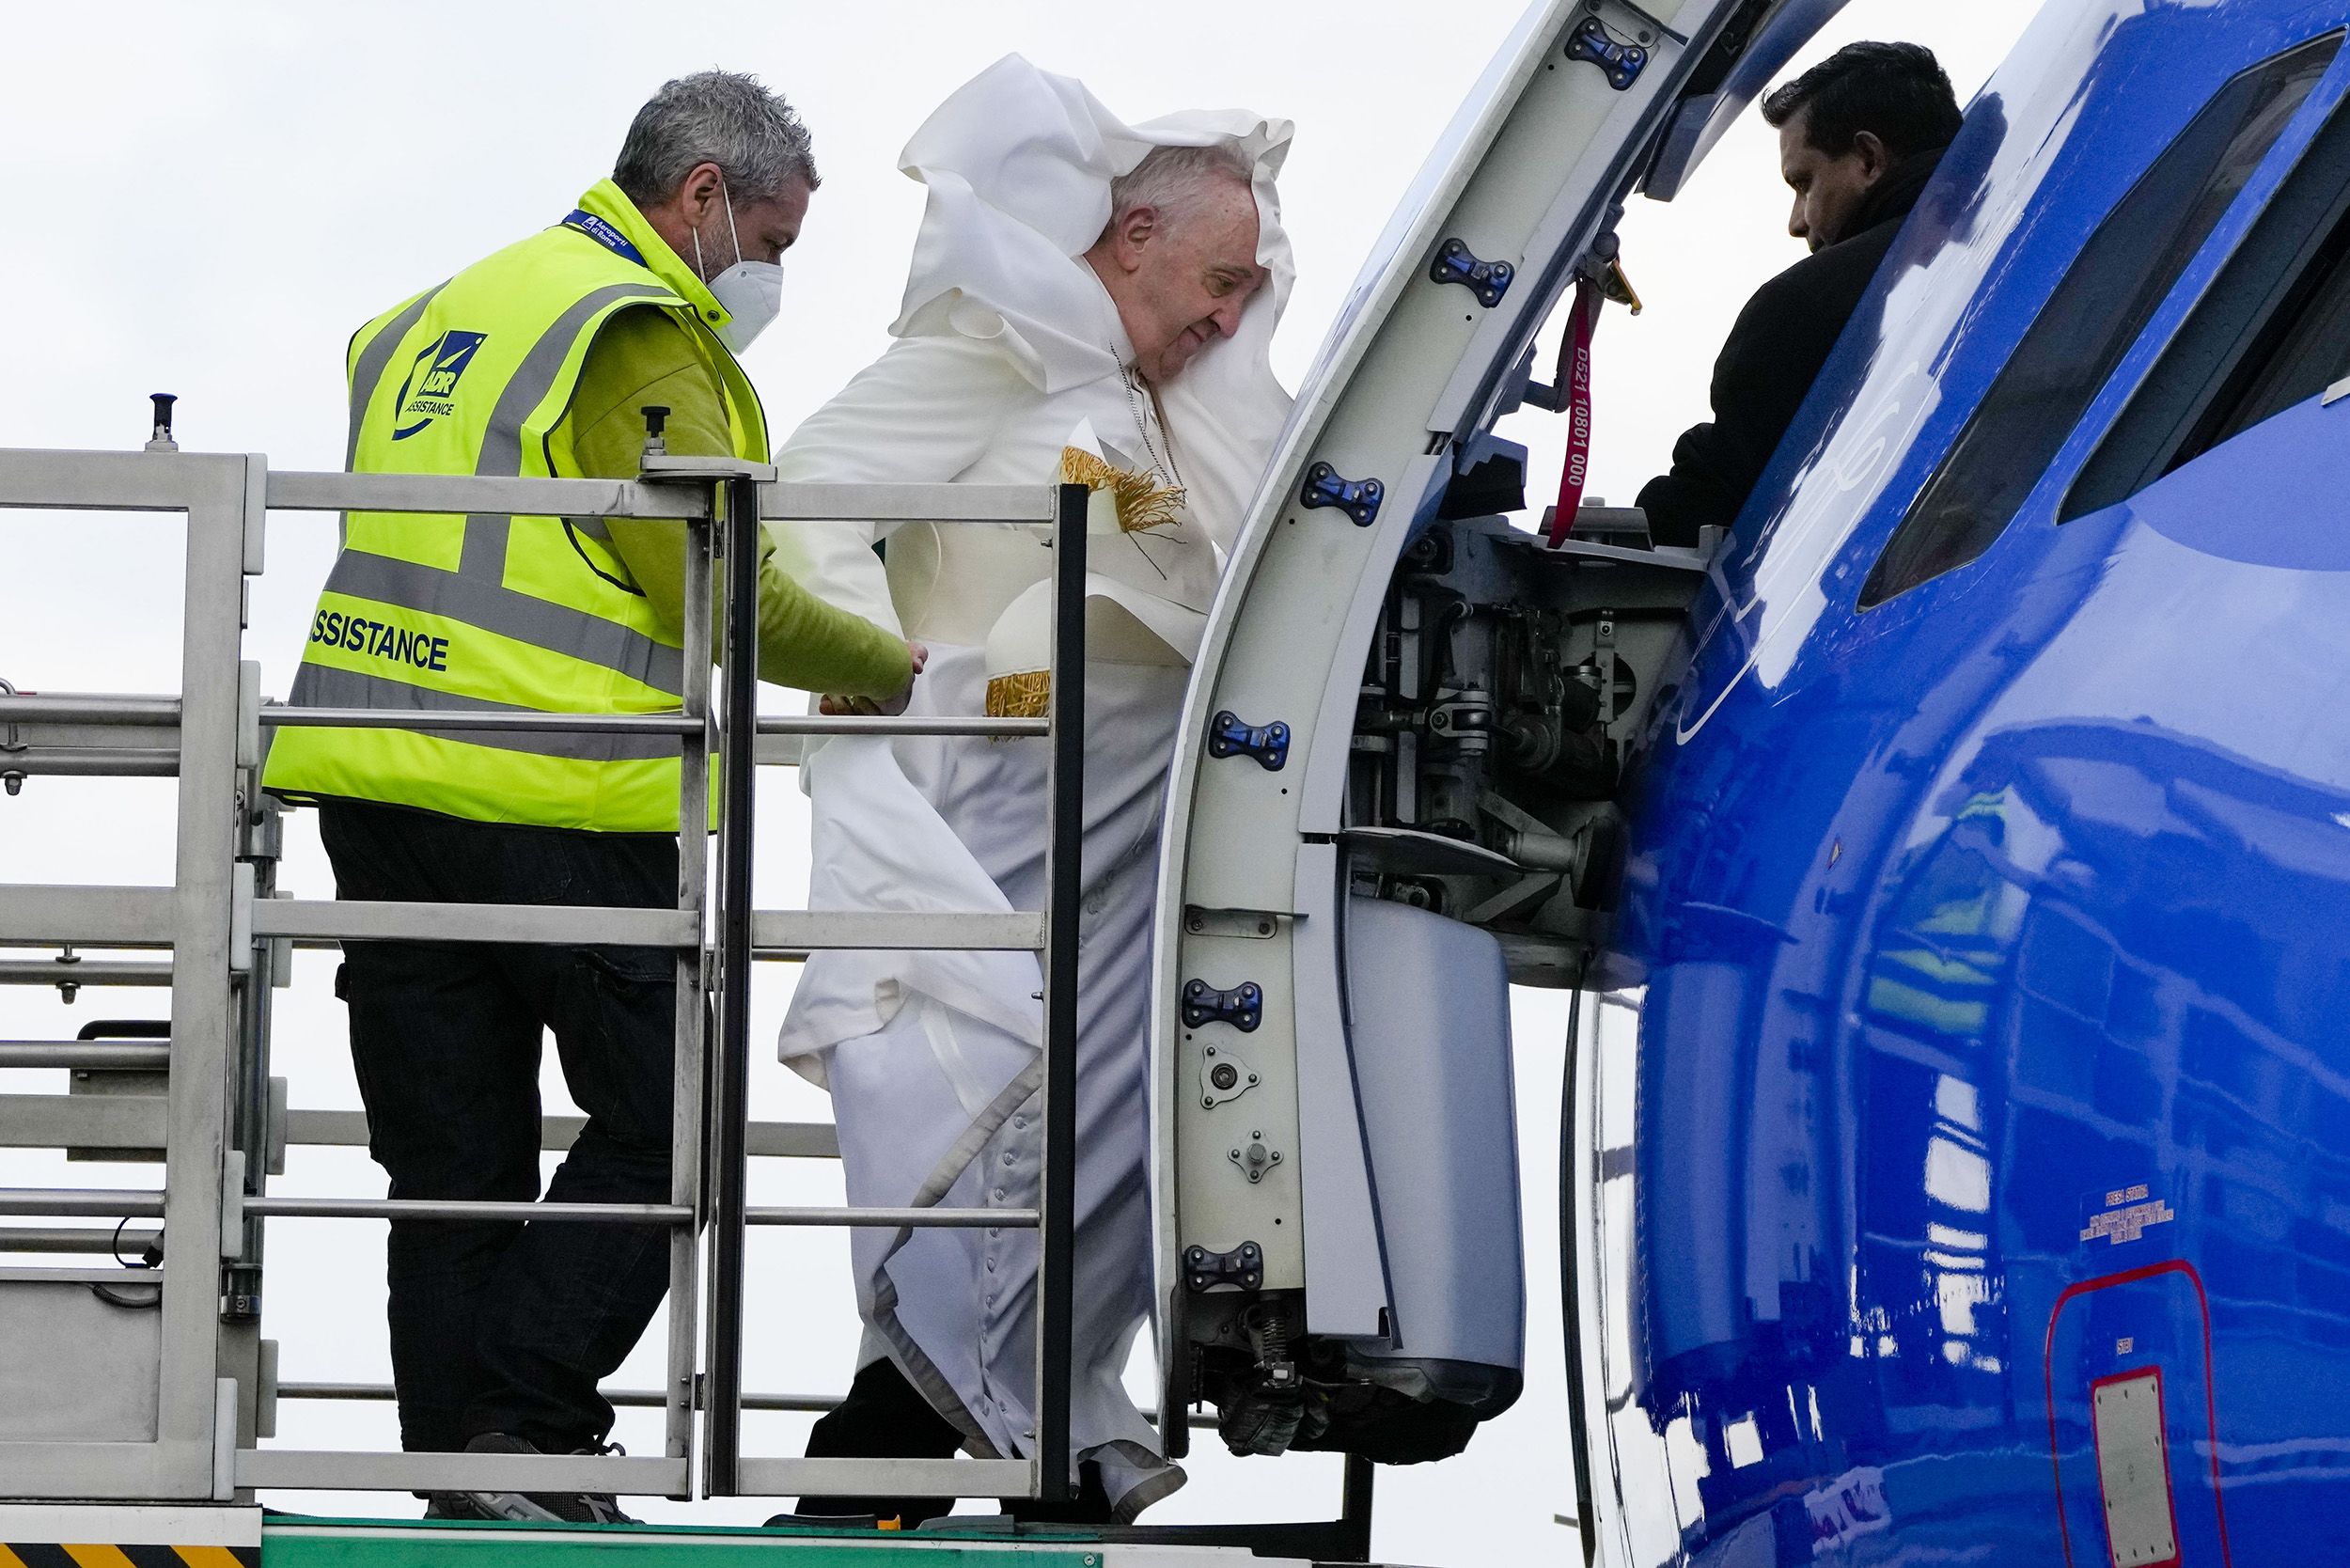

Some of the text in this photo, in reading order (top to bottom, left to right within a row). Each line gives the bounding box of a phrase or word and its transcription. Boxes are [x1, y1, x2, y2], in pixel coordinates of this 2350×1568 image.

[596, 221, 629, 246] Aeroporti
[597, 230, 617, 247] Roma
[419, 370, 456, 394] ADR
[1568, 347, 1589, 487] D521 10801 000
[308, 609, 448, 672] SSISTANCE
